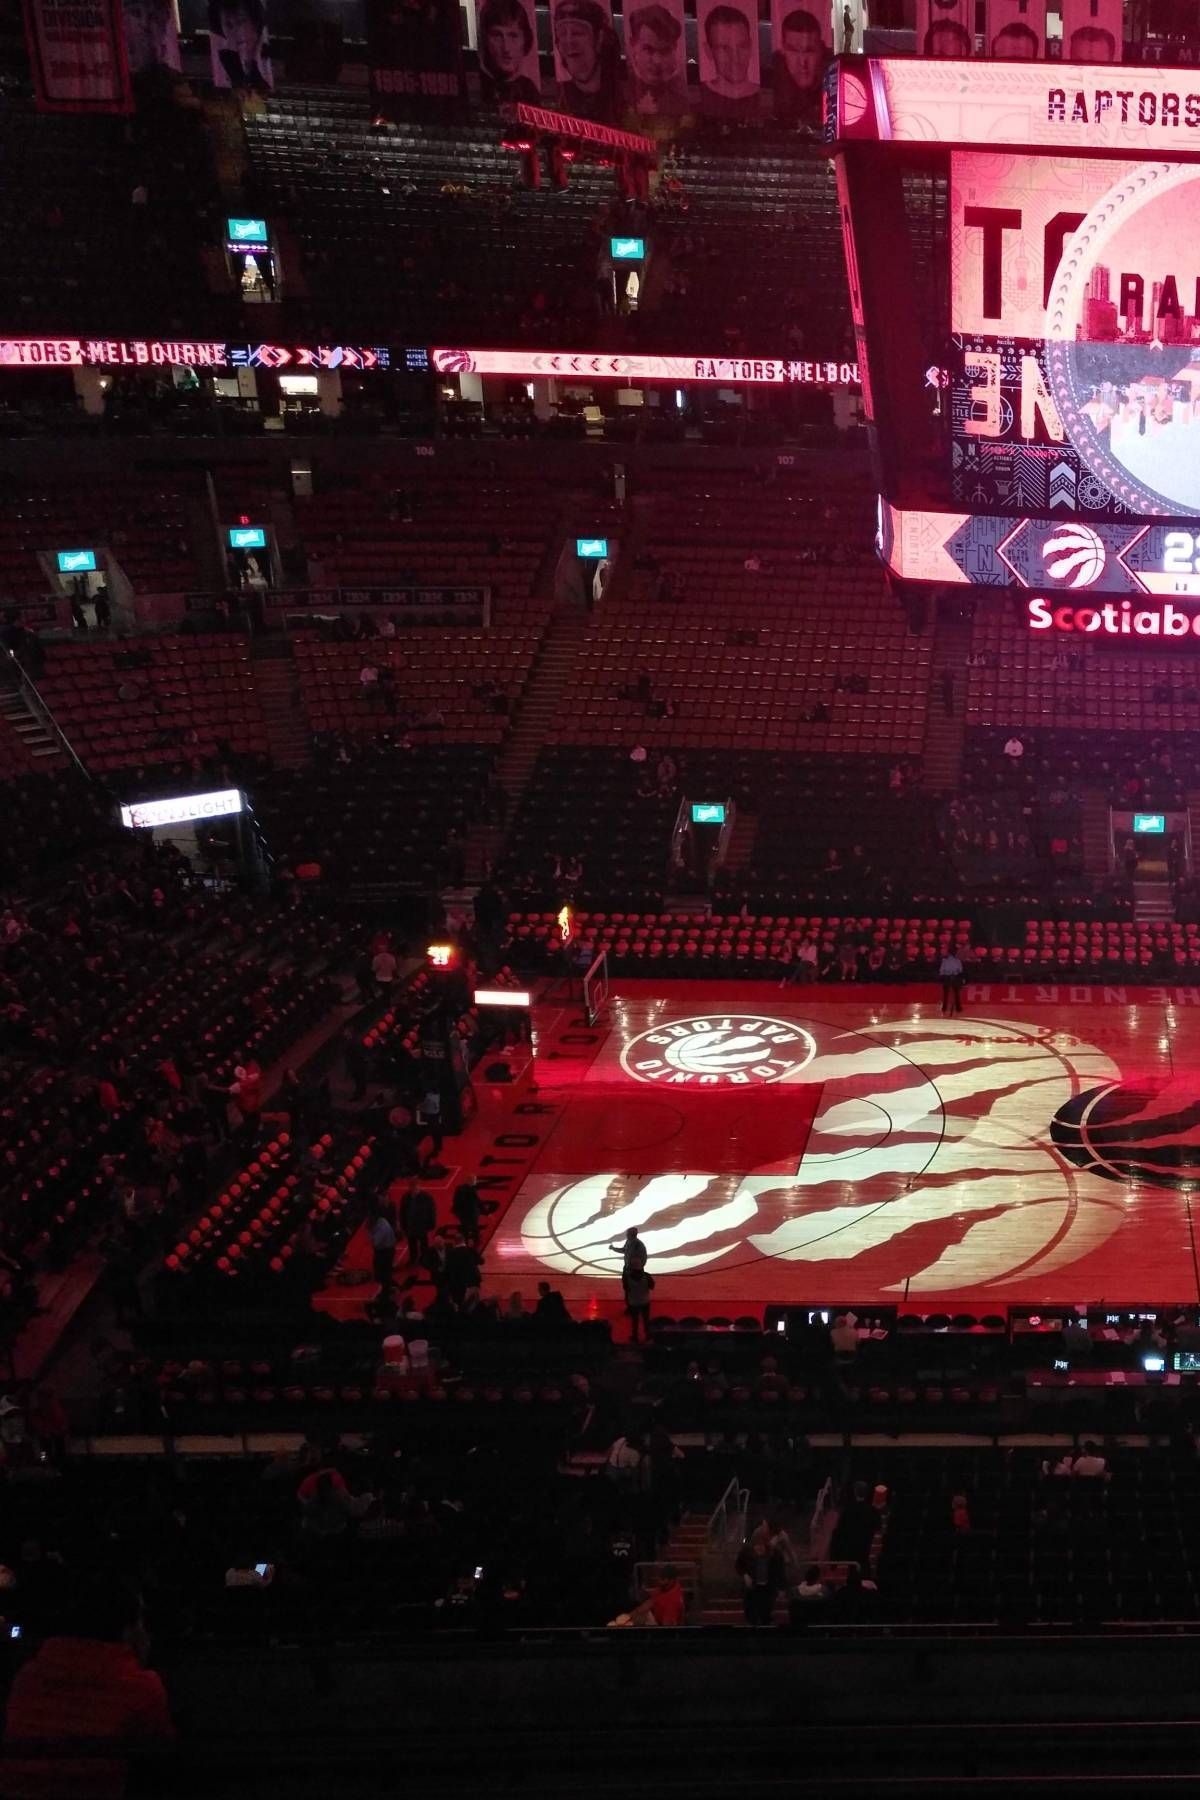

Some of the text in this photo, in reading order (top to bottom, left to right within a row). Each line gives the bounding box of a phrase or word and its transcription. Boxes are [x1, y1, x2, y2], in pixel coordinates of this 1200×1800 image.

[90, 342, 225, 365] MELBOURNE
[189, 799, 236, 817] LIGHT
[966, 985, 1127, 1004] NORTH
[645, 1018, 800, 1045] RAPTORS
[635, 1058, 796, 1084] TORONTO
